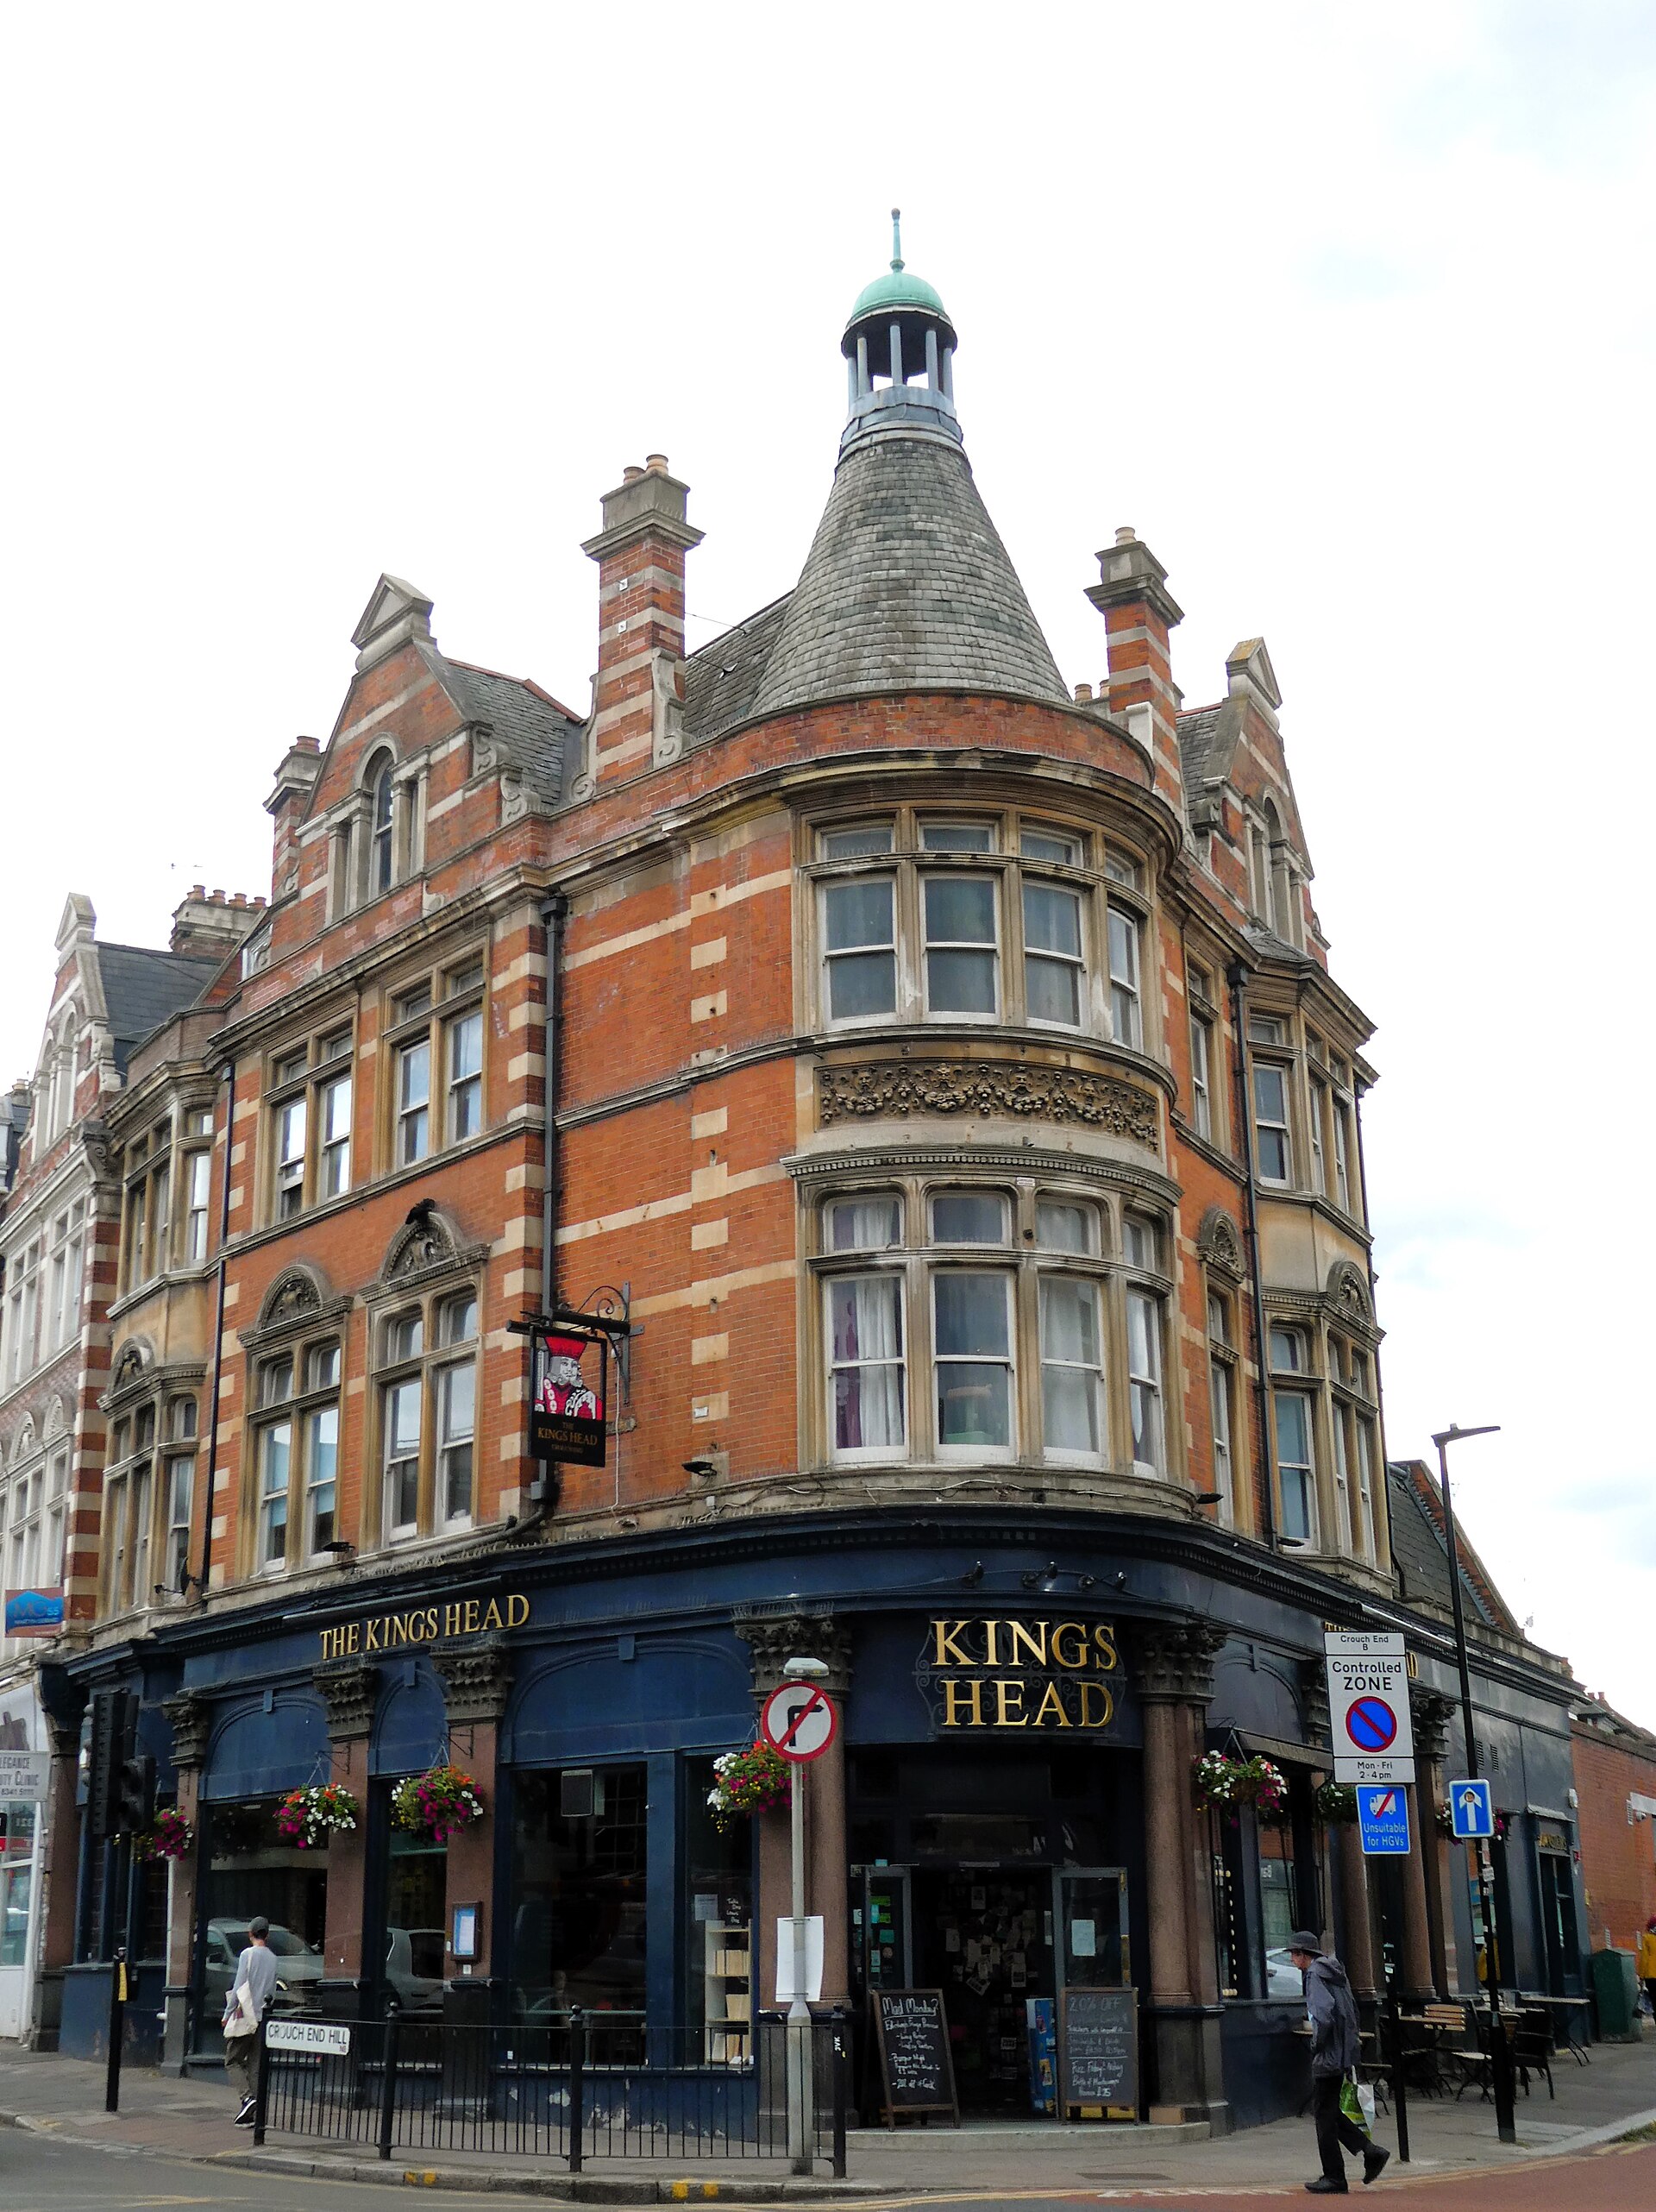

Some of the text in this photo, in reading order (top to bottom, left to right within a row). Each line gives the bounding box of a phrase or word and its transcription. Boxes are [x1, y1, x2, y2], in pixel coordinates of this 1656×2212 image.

[538, 1427, 598, 1446] KINGS HEAD
[319, 1594, 530, 1660] THE KINGS HEAD
[931, 1620, 1117, 1670] KINGS
[1373, 1635, 1389, 1643] End
[1333, 1661, 1402, 1674] Controlled
[1343, 1676, 1393, 1691] ZONE
[940, 1680, 1114, 1728] HEAD
[1363, 1822, 1407, 1833] Unsuitable
[1367, 1835, 1404, 1846] for HGVs
[268, 2024, 347, 2045] CROUCH END HILL
